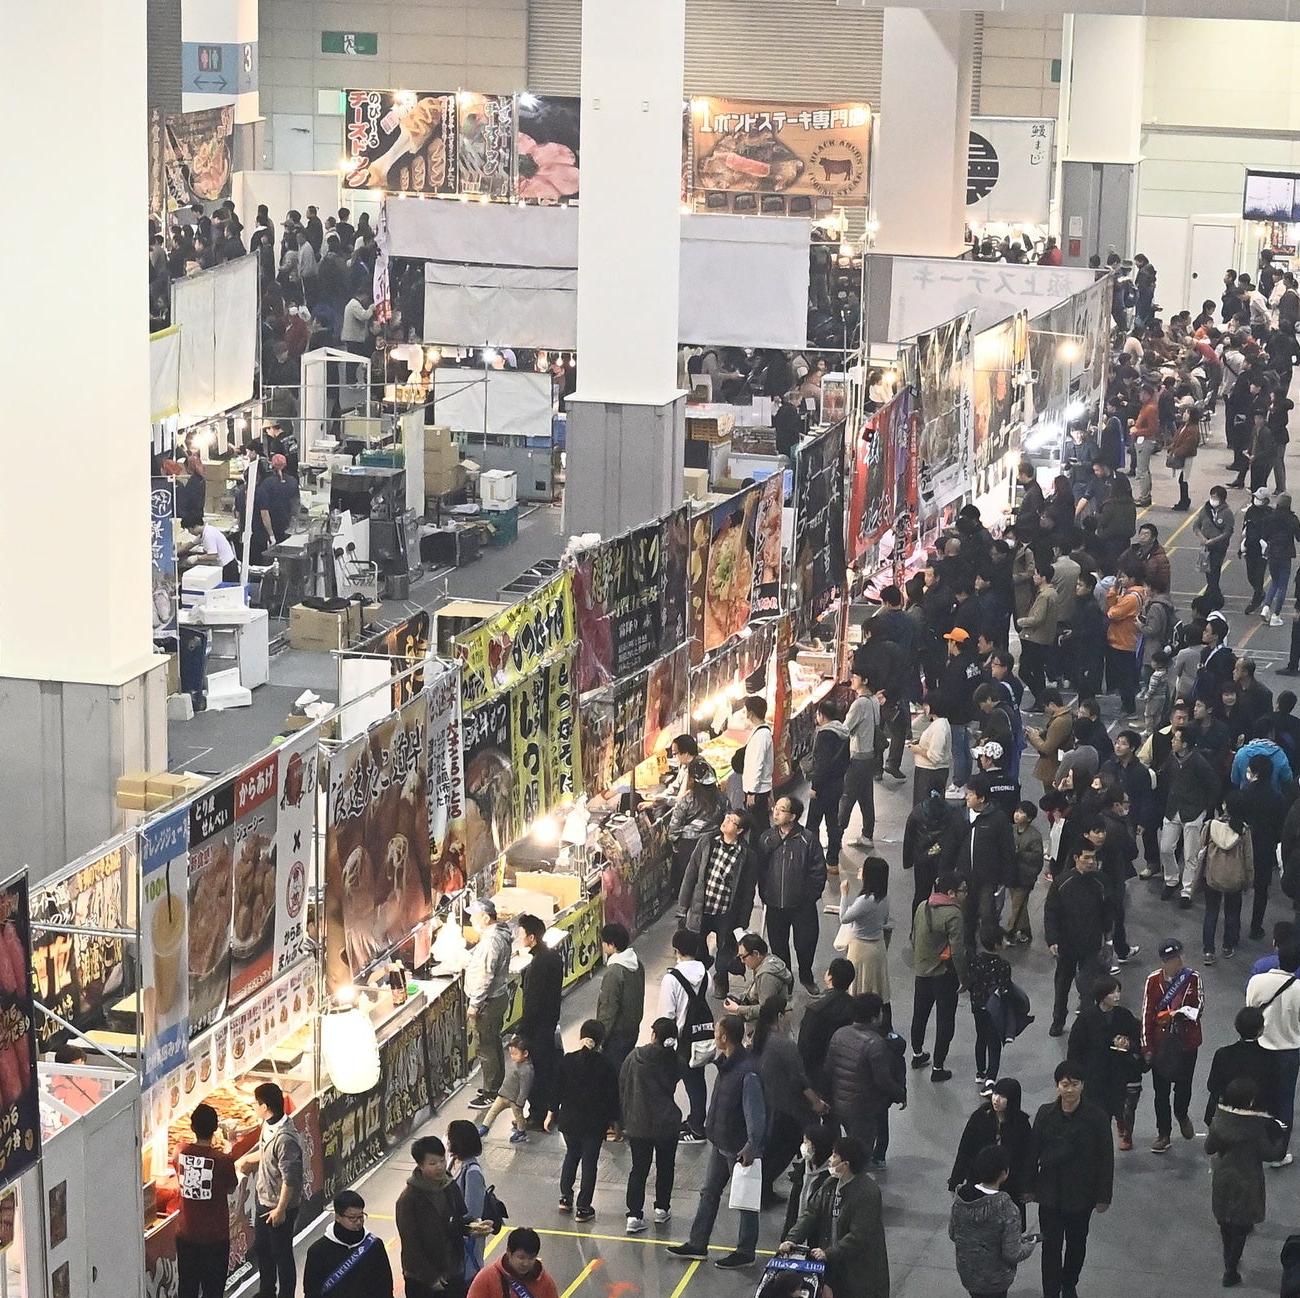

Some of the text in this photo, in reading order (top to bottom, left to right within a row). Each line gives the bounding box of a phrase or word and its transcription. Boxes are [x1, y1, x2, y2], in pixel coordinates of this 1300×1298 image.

[243, 44, 253, 73] 3
[347, 91, 369, 188] チーズドッグ
[238, 763, 276, 808] からあげ
